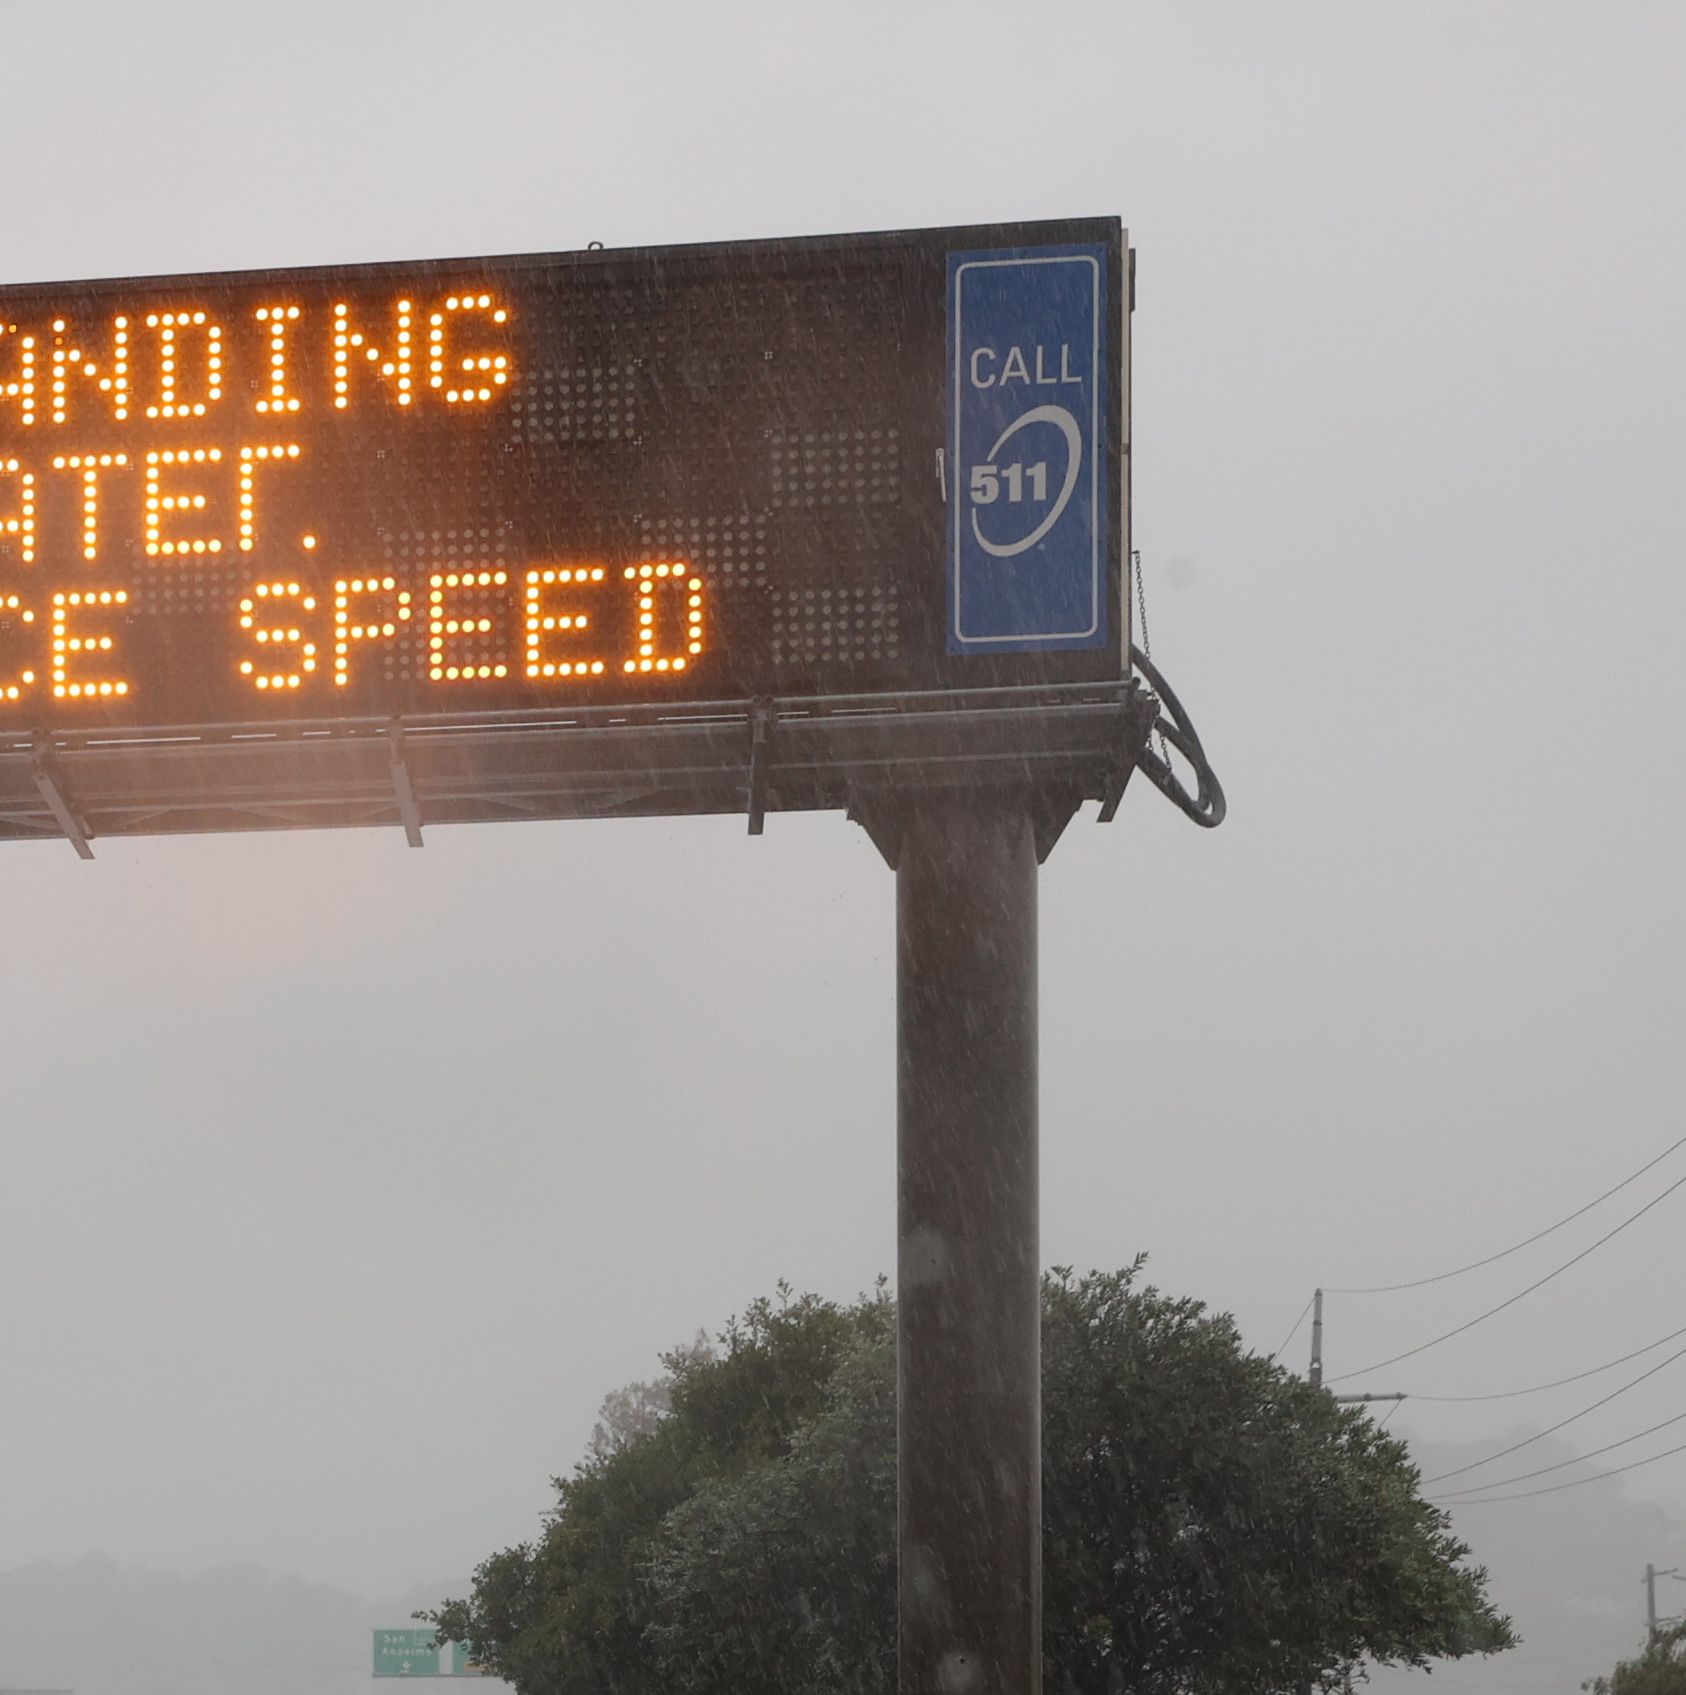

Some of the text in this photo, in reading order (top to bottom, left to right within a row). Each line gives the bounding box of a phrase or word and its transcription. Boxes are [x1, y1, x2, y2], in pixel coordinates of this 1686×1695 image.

[971, 344, 1082, 389] CALL
[971, 461, 1048, 505] 511
[238, 562, 703, 693] SPEED
[383, 1634, 406, 1643] San
